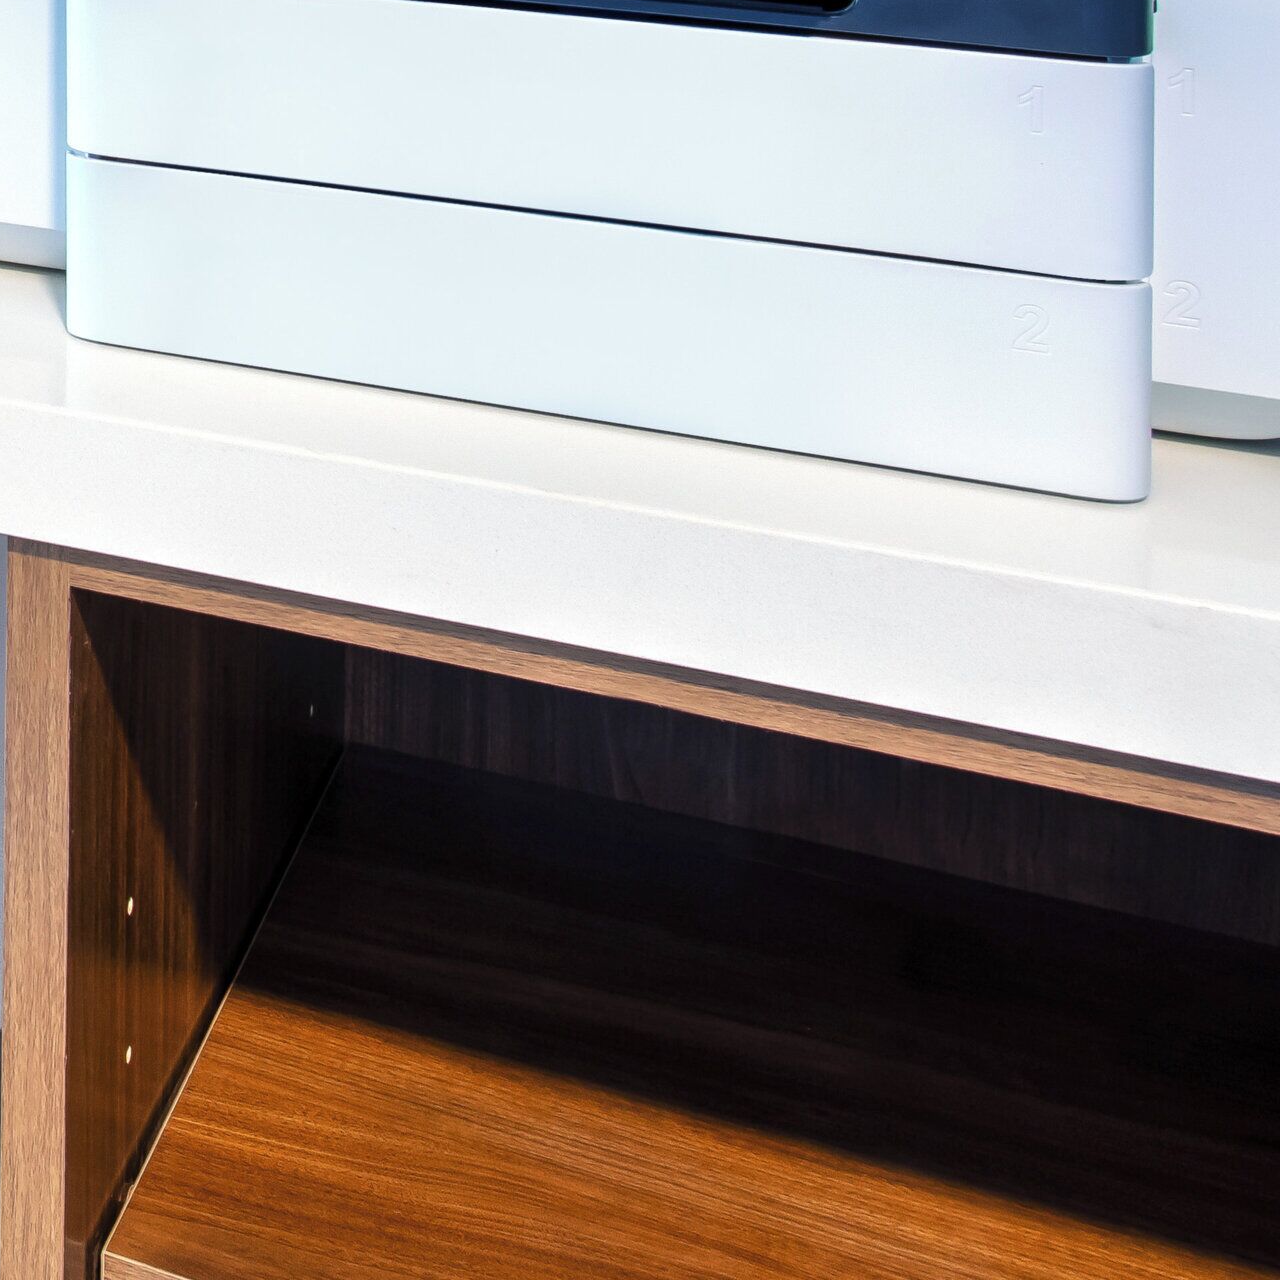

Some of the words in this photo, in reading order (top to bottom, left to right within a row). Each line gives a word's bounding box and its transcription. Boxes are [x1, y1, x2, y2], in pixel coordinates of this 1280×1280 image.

[1017, 85, 1044, 135] 1
[1167, 67, 1195, 117] 1
[1161, 279, 1202, 329] 2
[1011, 304, 1050, 355] 2
